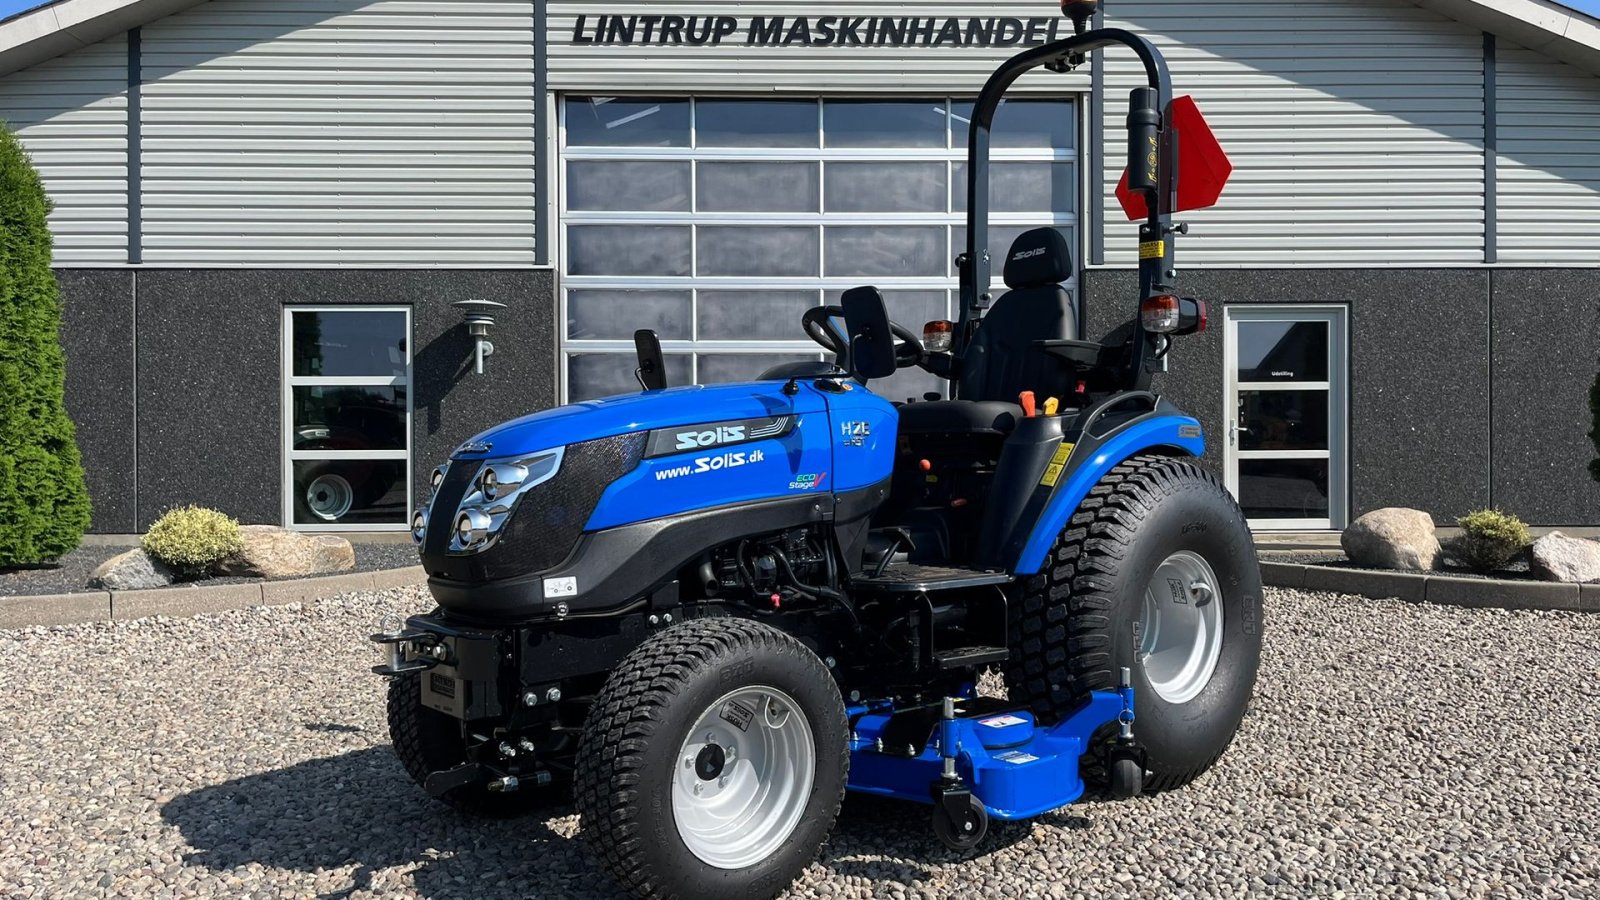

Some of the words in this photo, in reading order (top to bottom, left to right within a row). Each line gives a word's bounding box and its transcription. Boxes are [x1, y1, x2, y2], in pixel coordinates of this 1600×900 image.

[573, 14, 738, 44] LINTRUP
[747, 16, 1060, 46] MASKINHANDEL
[796, 473, 816, 482] ECO
